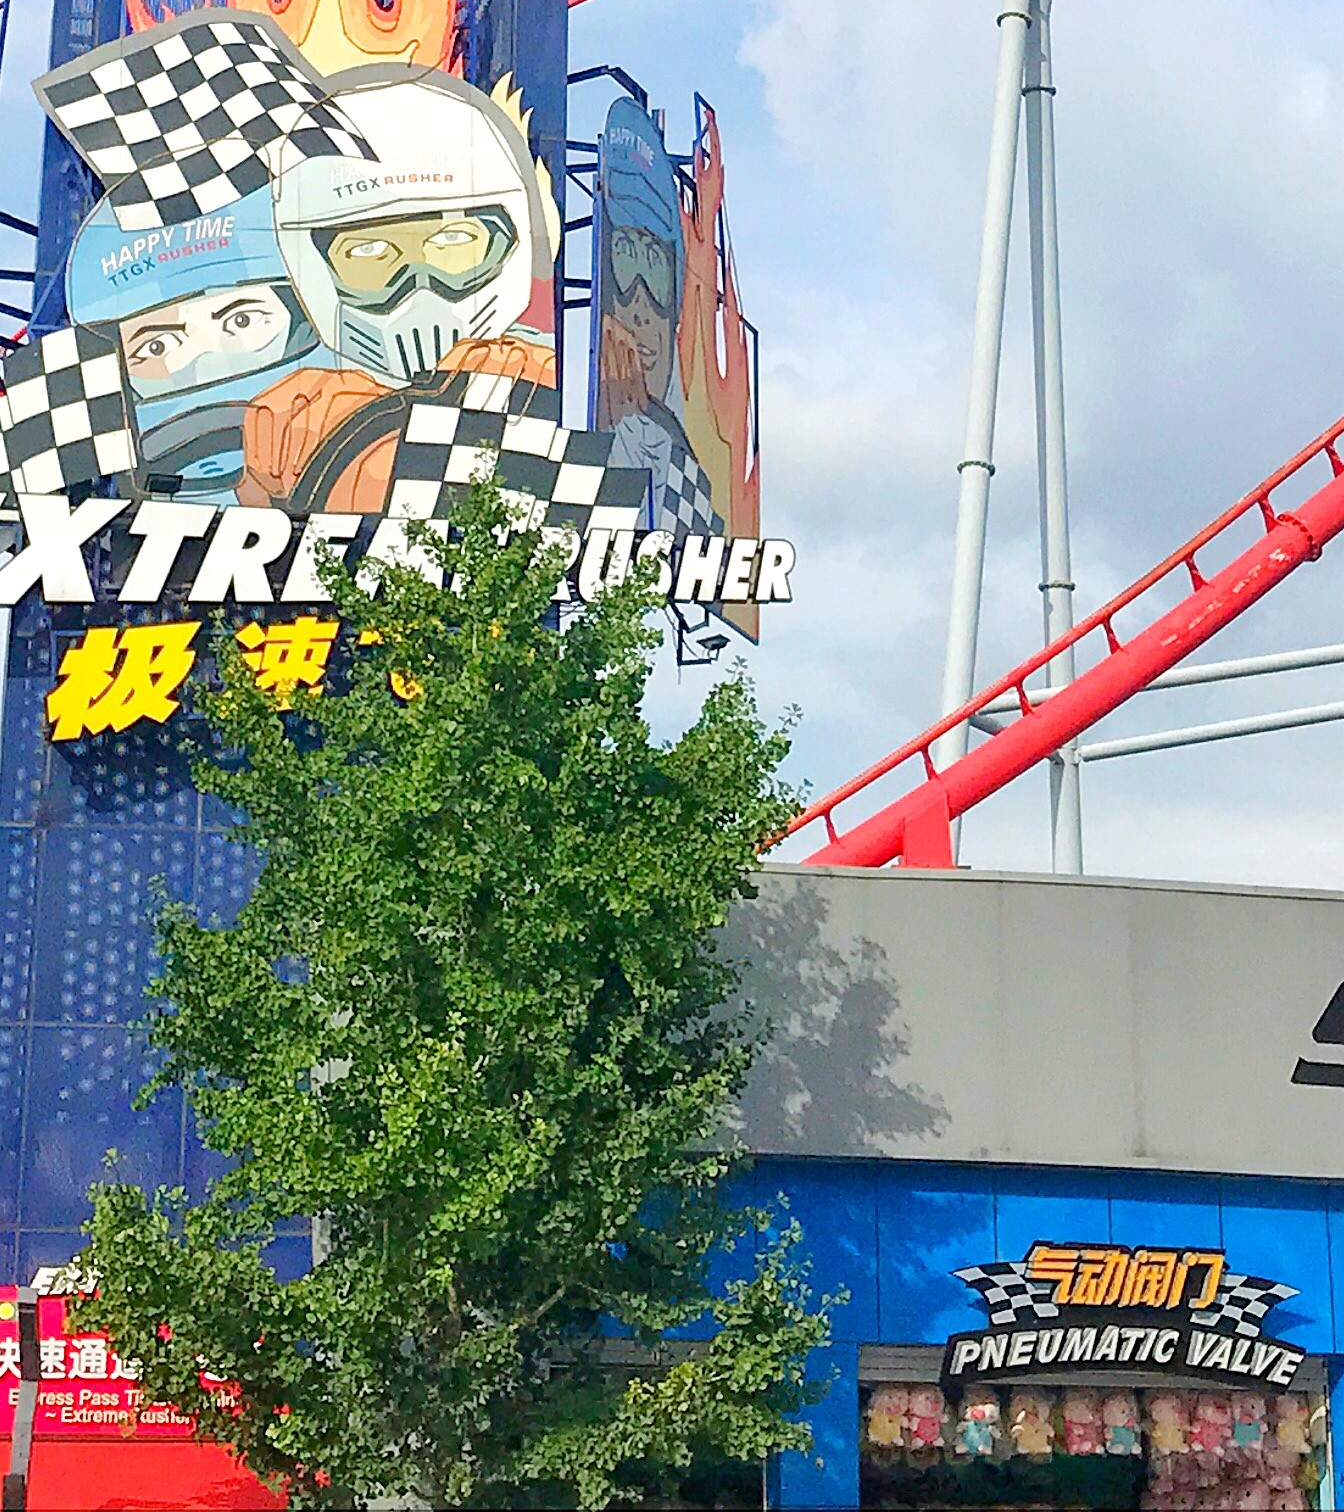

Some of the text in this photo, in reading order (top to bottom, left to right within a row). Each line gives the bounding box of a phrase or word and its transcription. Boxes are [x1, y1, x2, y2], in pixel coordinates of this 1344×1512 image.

[333, 173, 455, 199] TTGX RUSHER
[100, 215, 236, 276] HAPPY TIME
[107, 237, 229, 287] TTGX RUSHER
[45, 616, 424, 742] 极速
[1025, 1245, 1225, 1310] 气动阀门
[950, 1324, 1306, 1386] PNEUMATIC VALVE
[8, 1389, 74, 1406] Eress
[79, 1389, 120, 1406] Pass
